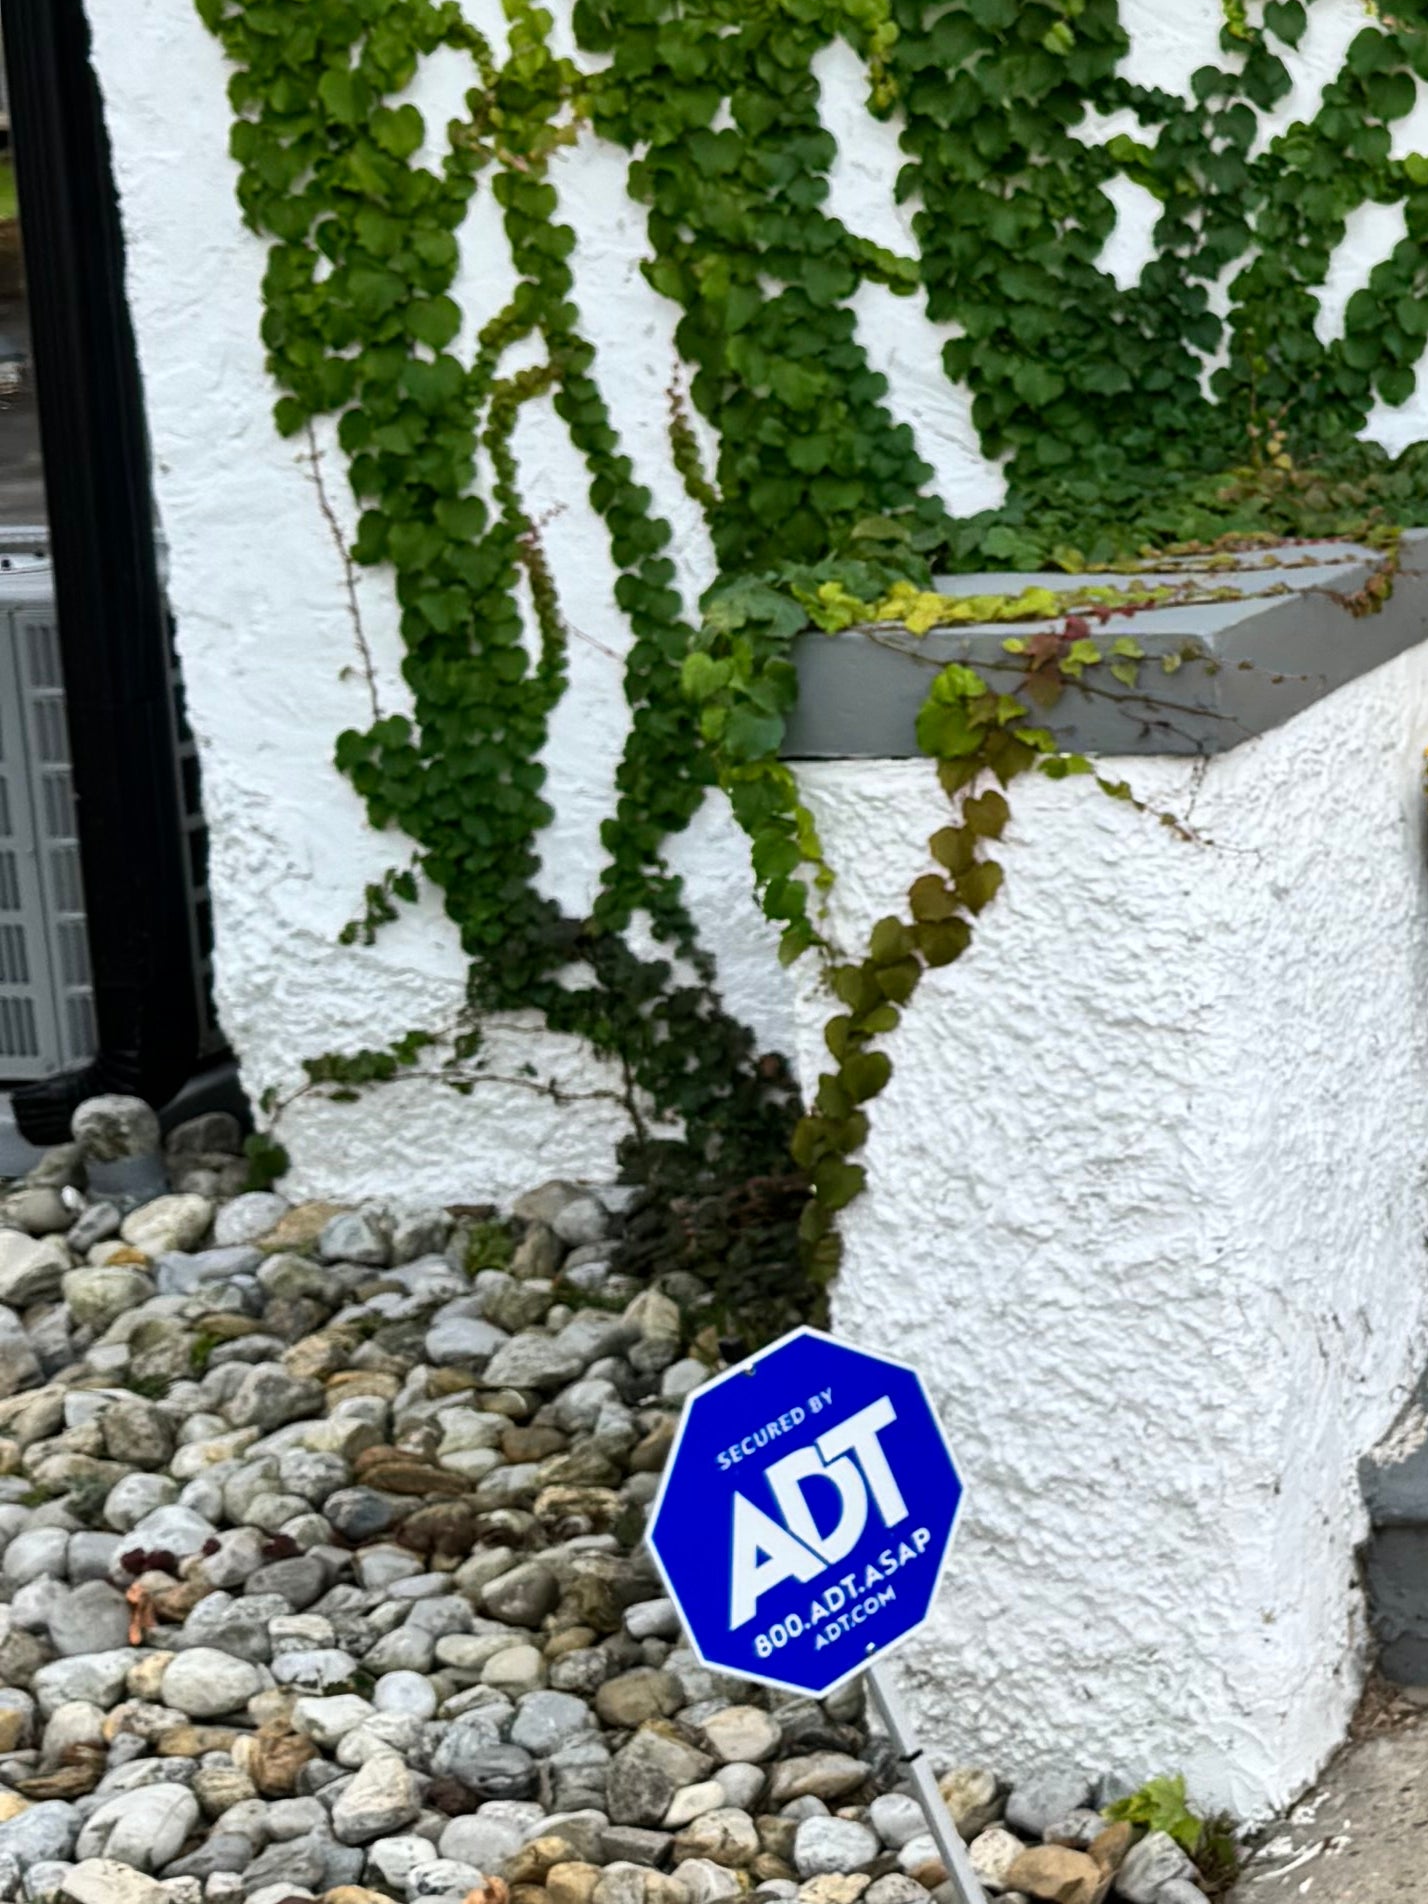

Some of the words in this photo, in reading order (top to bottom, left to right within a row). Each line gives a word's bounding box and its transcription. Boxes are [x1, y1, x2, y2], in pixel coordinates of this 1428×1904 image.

[715, 1406, 806, 1471] SECURED
[809, 1387, 834, 1414] BY
[730, 1395, 909, 1631] ADT
[754, 1527, 931, 1659] 800.ADT.ASAP
[814, 1585, 897, 1651] ADT.COM
